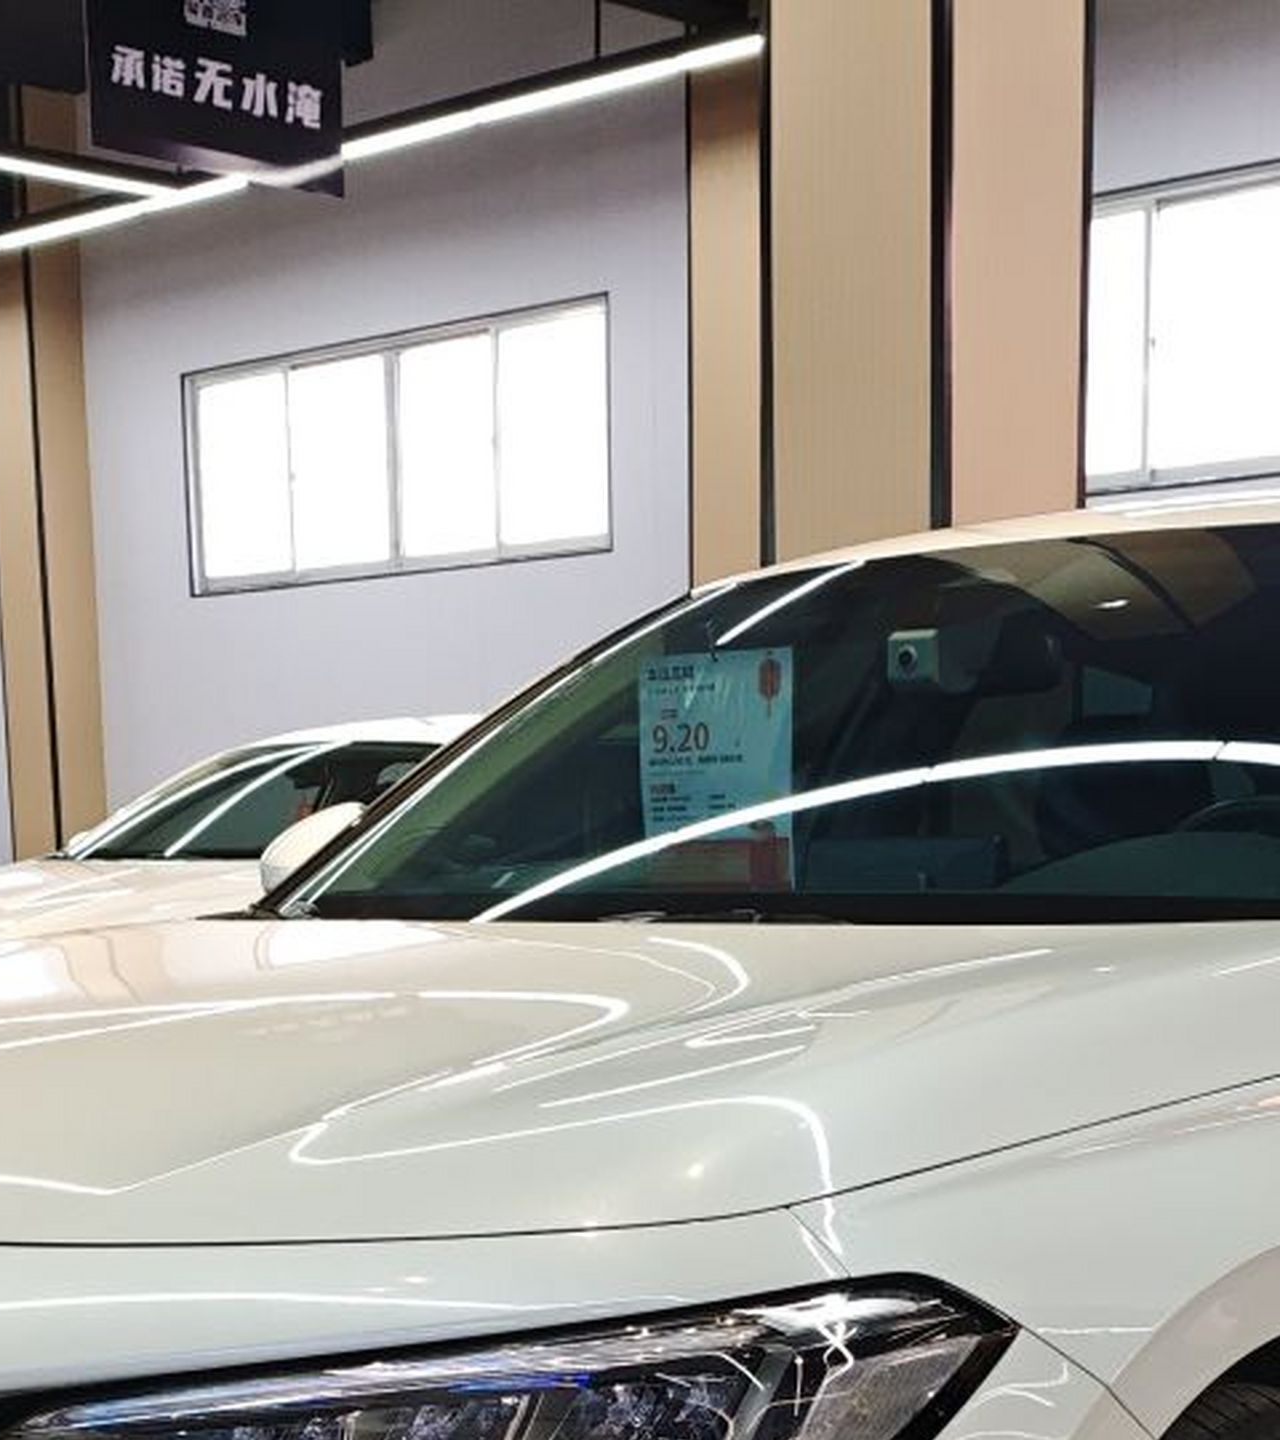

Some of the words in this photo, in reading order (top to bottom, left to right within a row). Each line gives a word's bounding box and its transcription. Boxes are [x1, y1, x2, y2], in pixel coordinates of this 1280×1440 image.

[111, 45, 322, 129] 承诺无水淹
[652, 721, 710, 753] 9.20
